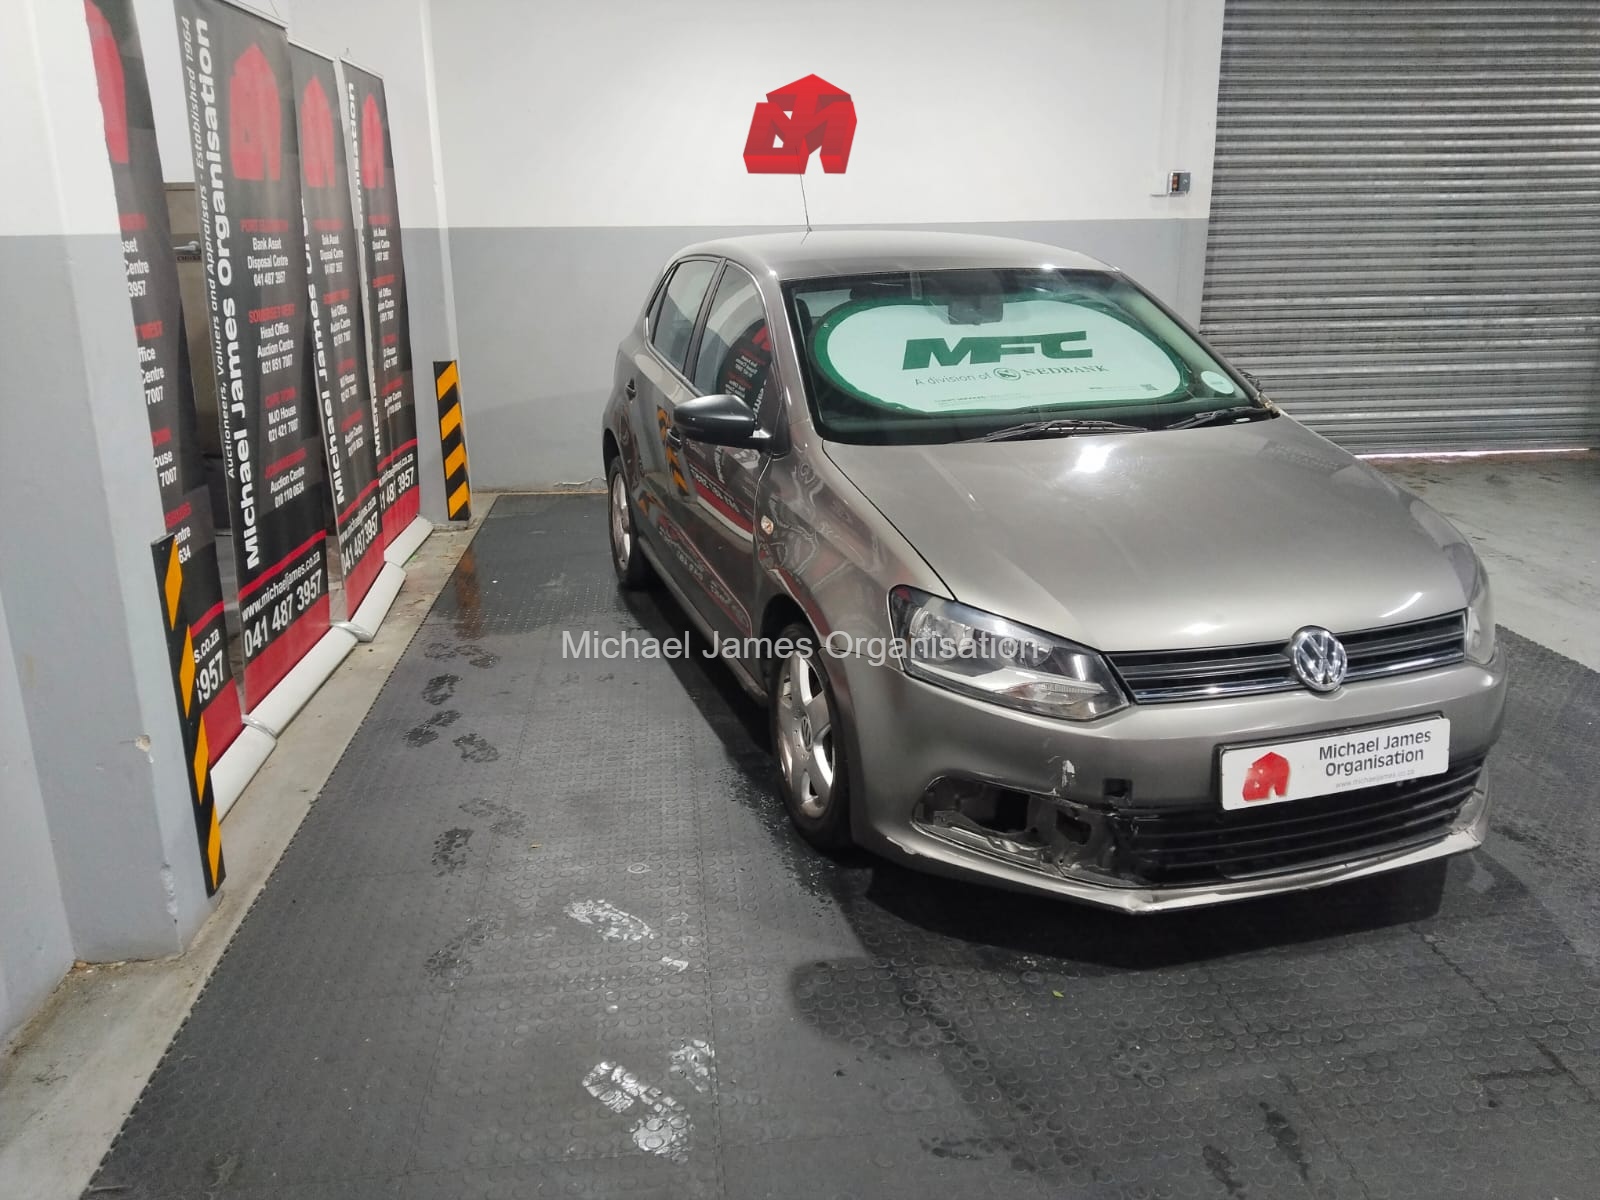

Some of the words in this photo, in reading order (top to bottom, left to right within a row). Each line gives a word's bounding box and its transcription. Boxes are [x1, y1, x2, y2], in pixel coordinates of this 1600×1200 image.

[181, 15, 194, 62] 1964
[196, 17, 232, 287] Organisation
[207, 279, 219, 311] and
[223, 297, 246, 419] James
[308, 283, 328, 382] James
[902, 330, 1093, 370] MFC
[926, 373, 976, 385] division
[1021, 364, 1109, 376] NEDBANK
[321, 390, 345, 504] Michael
[234, 428, 260, 570] Michael
[244, 615, 268, 658] 041
[272, 593, 293, 632] 487
[296, 568, 322, 611] 3957
[1318, 736, 1380, 761] Michael
[1383, 730, 1431, 750] James
[1326, 748, 1424, 776] Organisation
